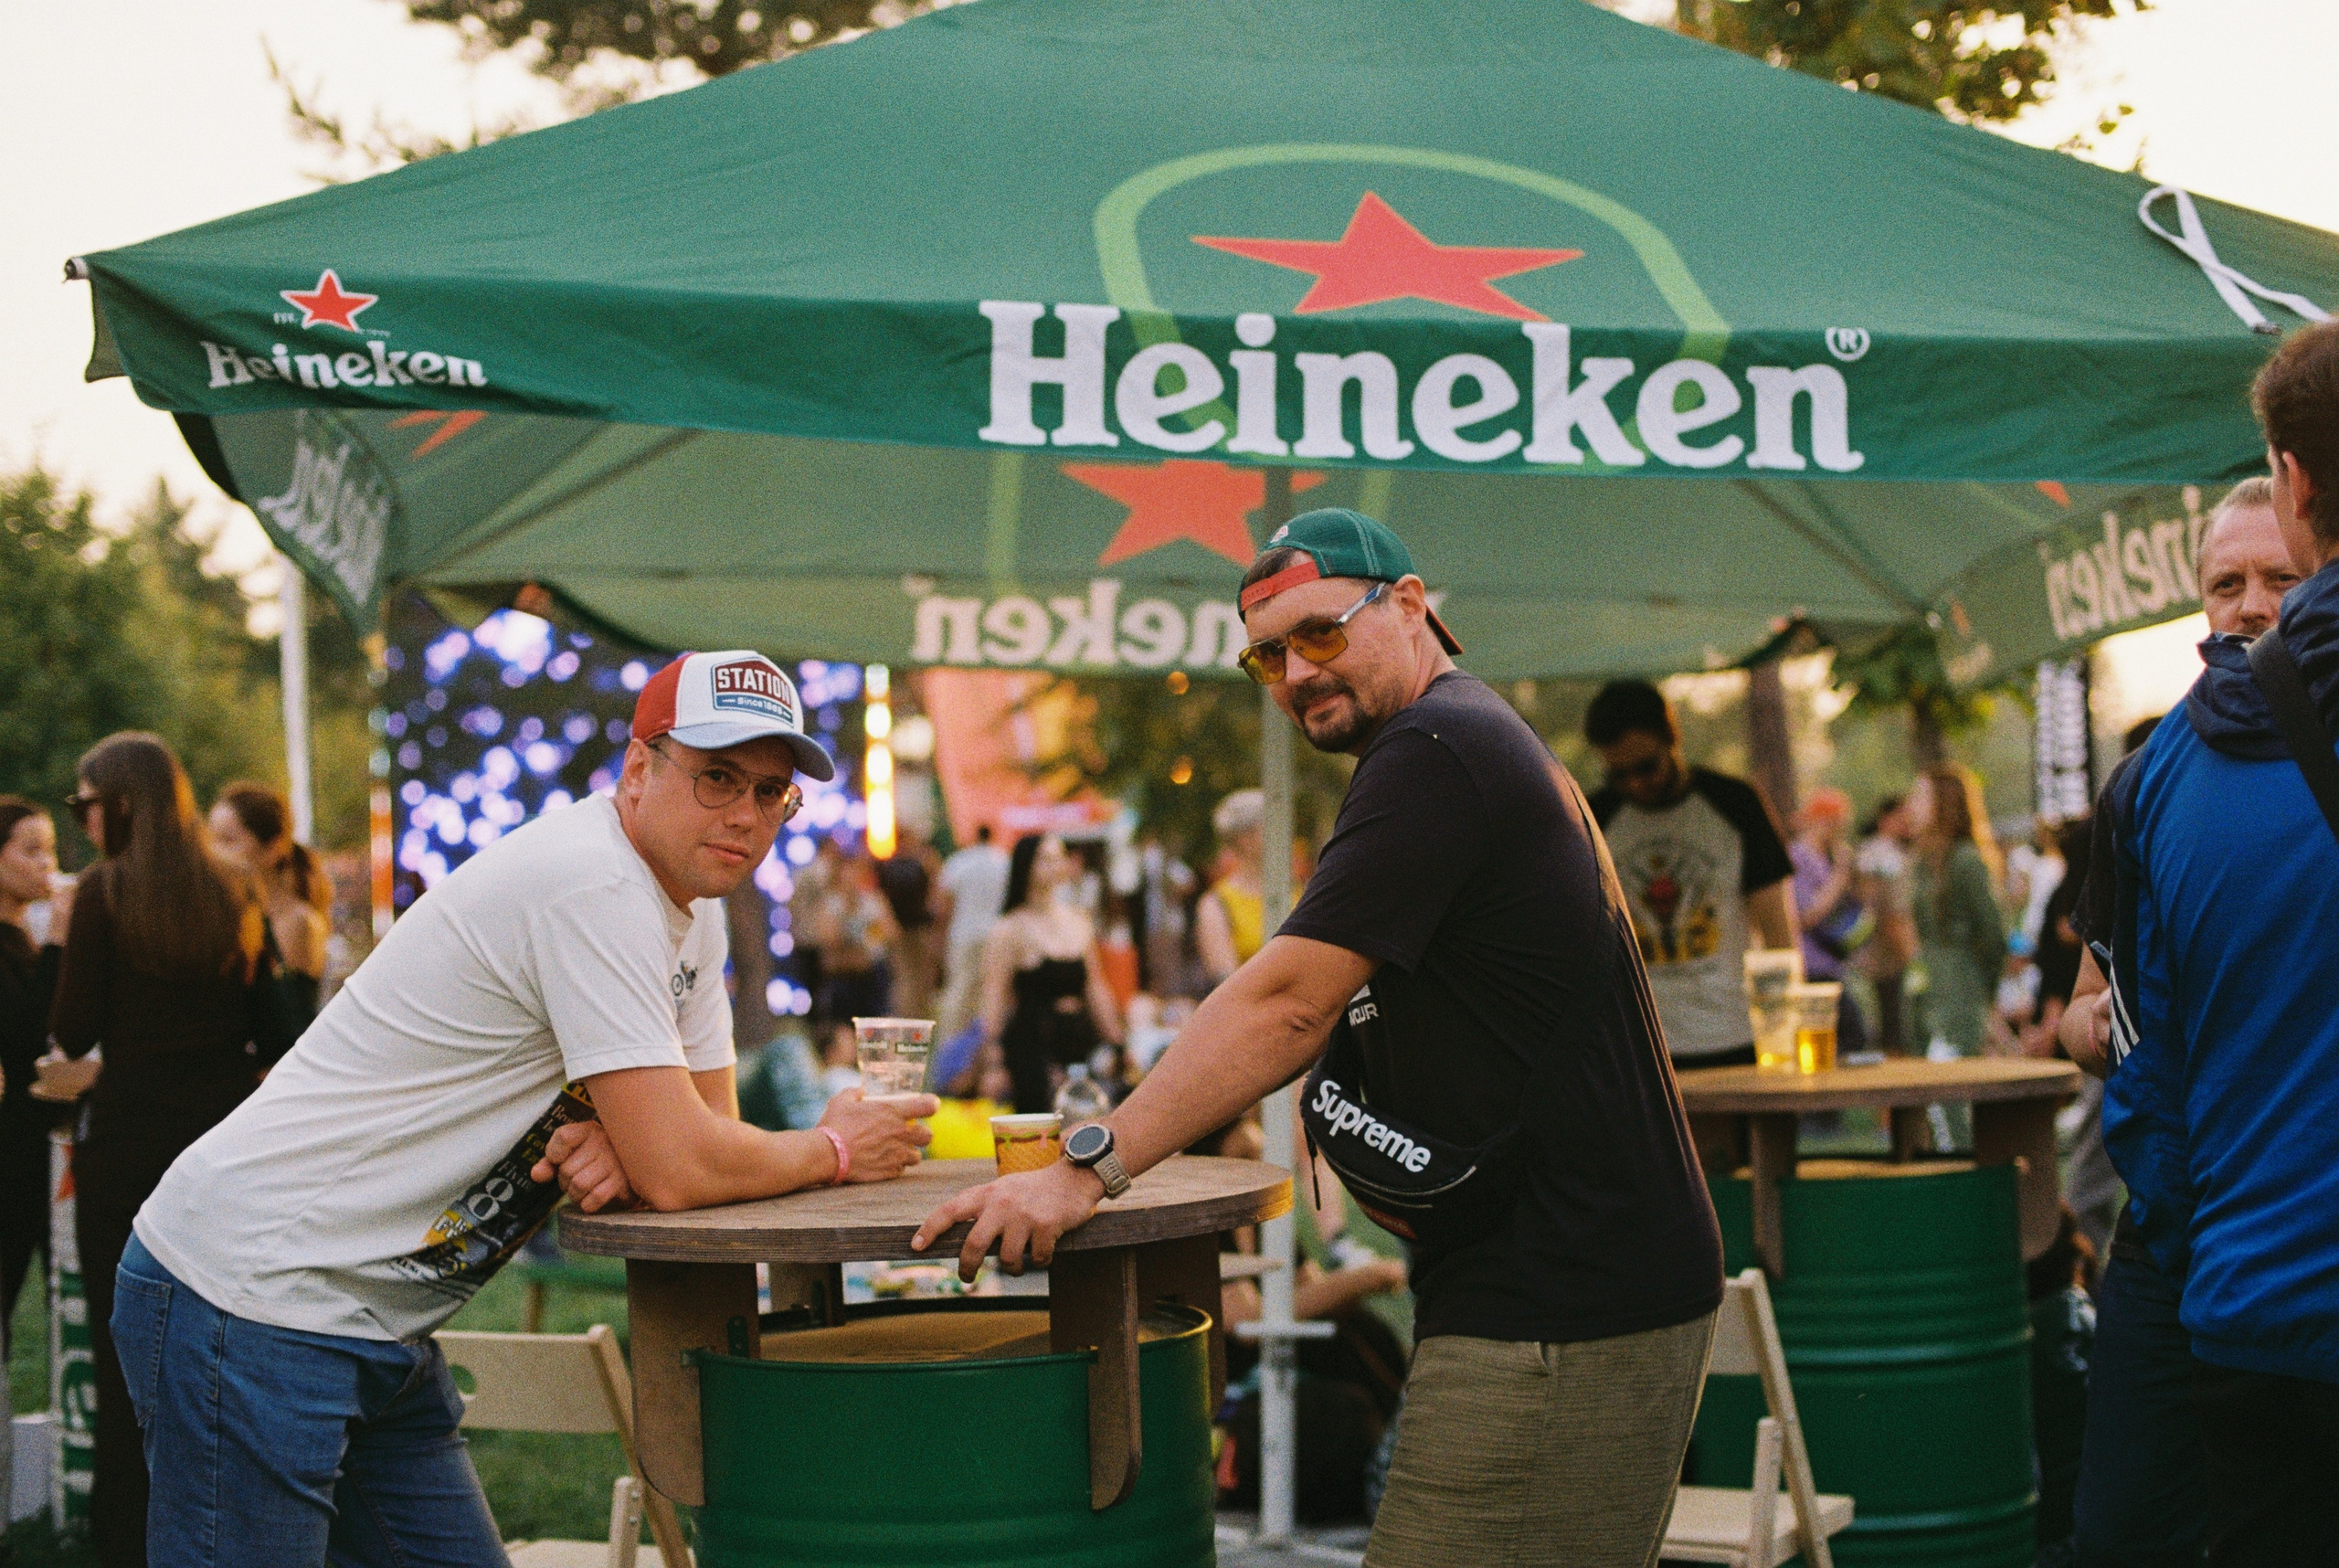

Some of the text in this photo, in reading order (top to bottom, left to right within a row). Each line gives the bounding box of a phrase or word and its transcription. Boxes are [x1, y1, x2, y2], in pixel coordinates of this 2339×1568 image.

[200, 340, 489, 389] Heineken
[716, 667, 791, 705] STATION
[1312, 1079, 1432, 1173] Supreme
